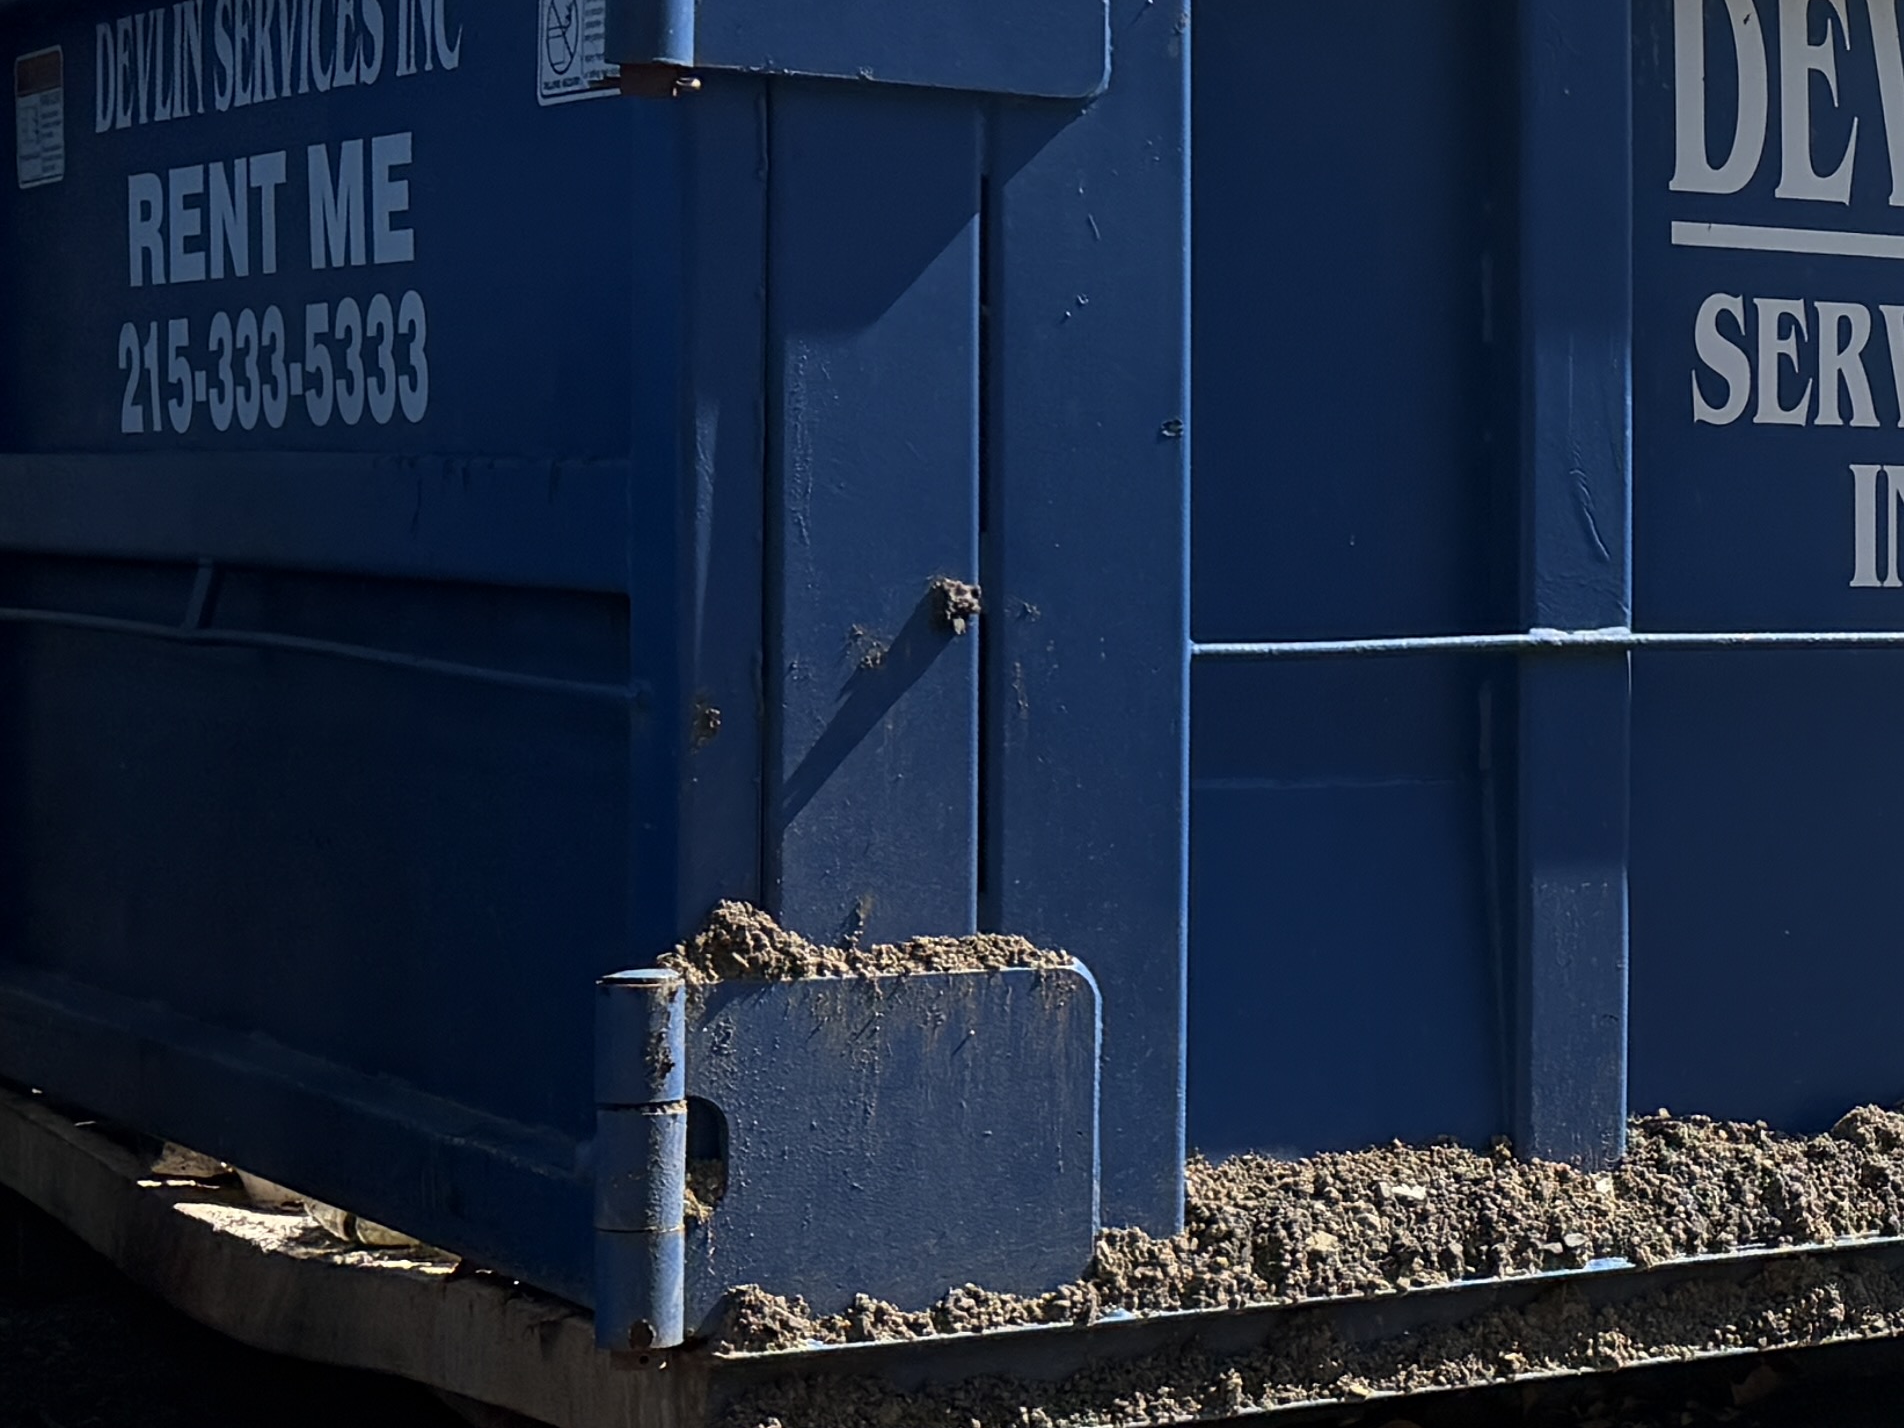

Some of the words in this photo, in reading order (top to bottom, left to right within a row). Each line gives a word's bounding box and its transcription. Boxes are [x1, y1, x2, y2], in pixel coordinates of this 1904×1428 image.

[128, 150, 287, 286] RENT
[307, 131, 414, 269] ME
[118, 290, 429, 434] 215-333-5333
